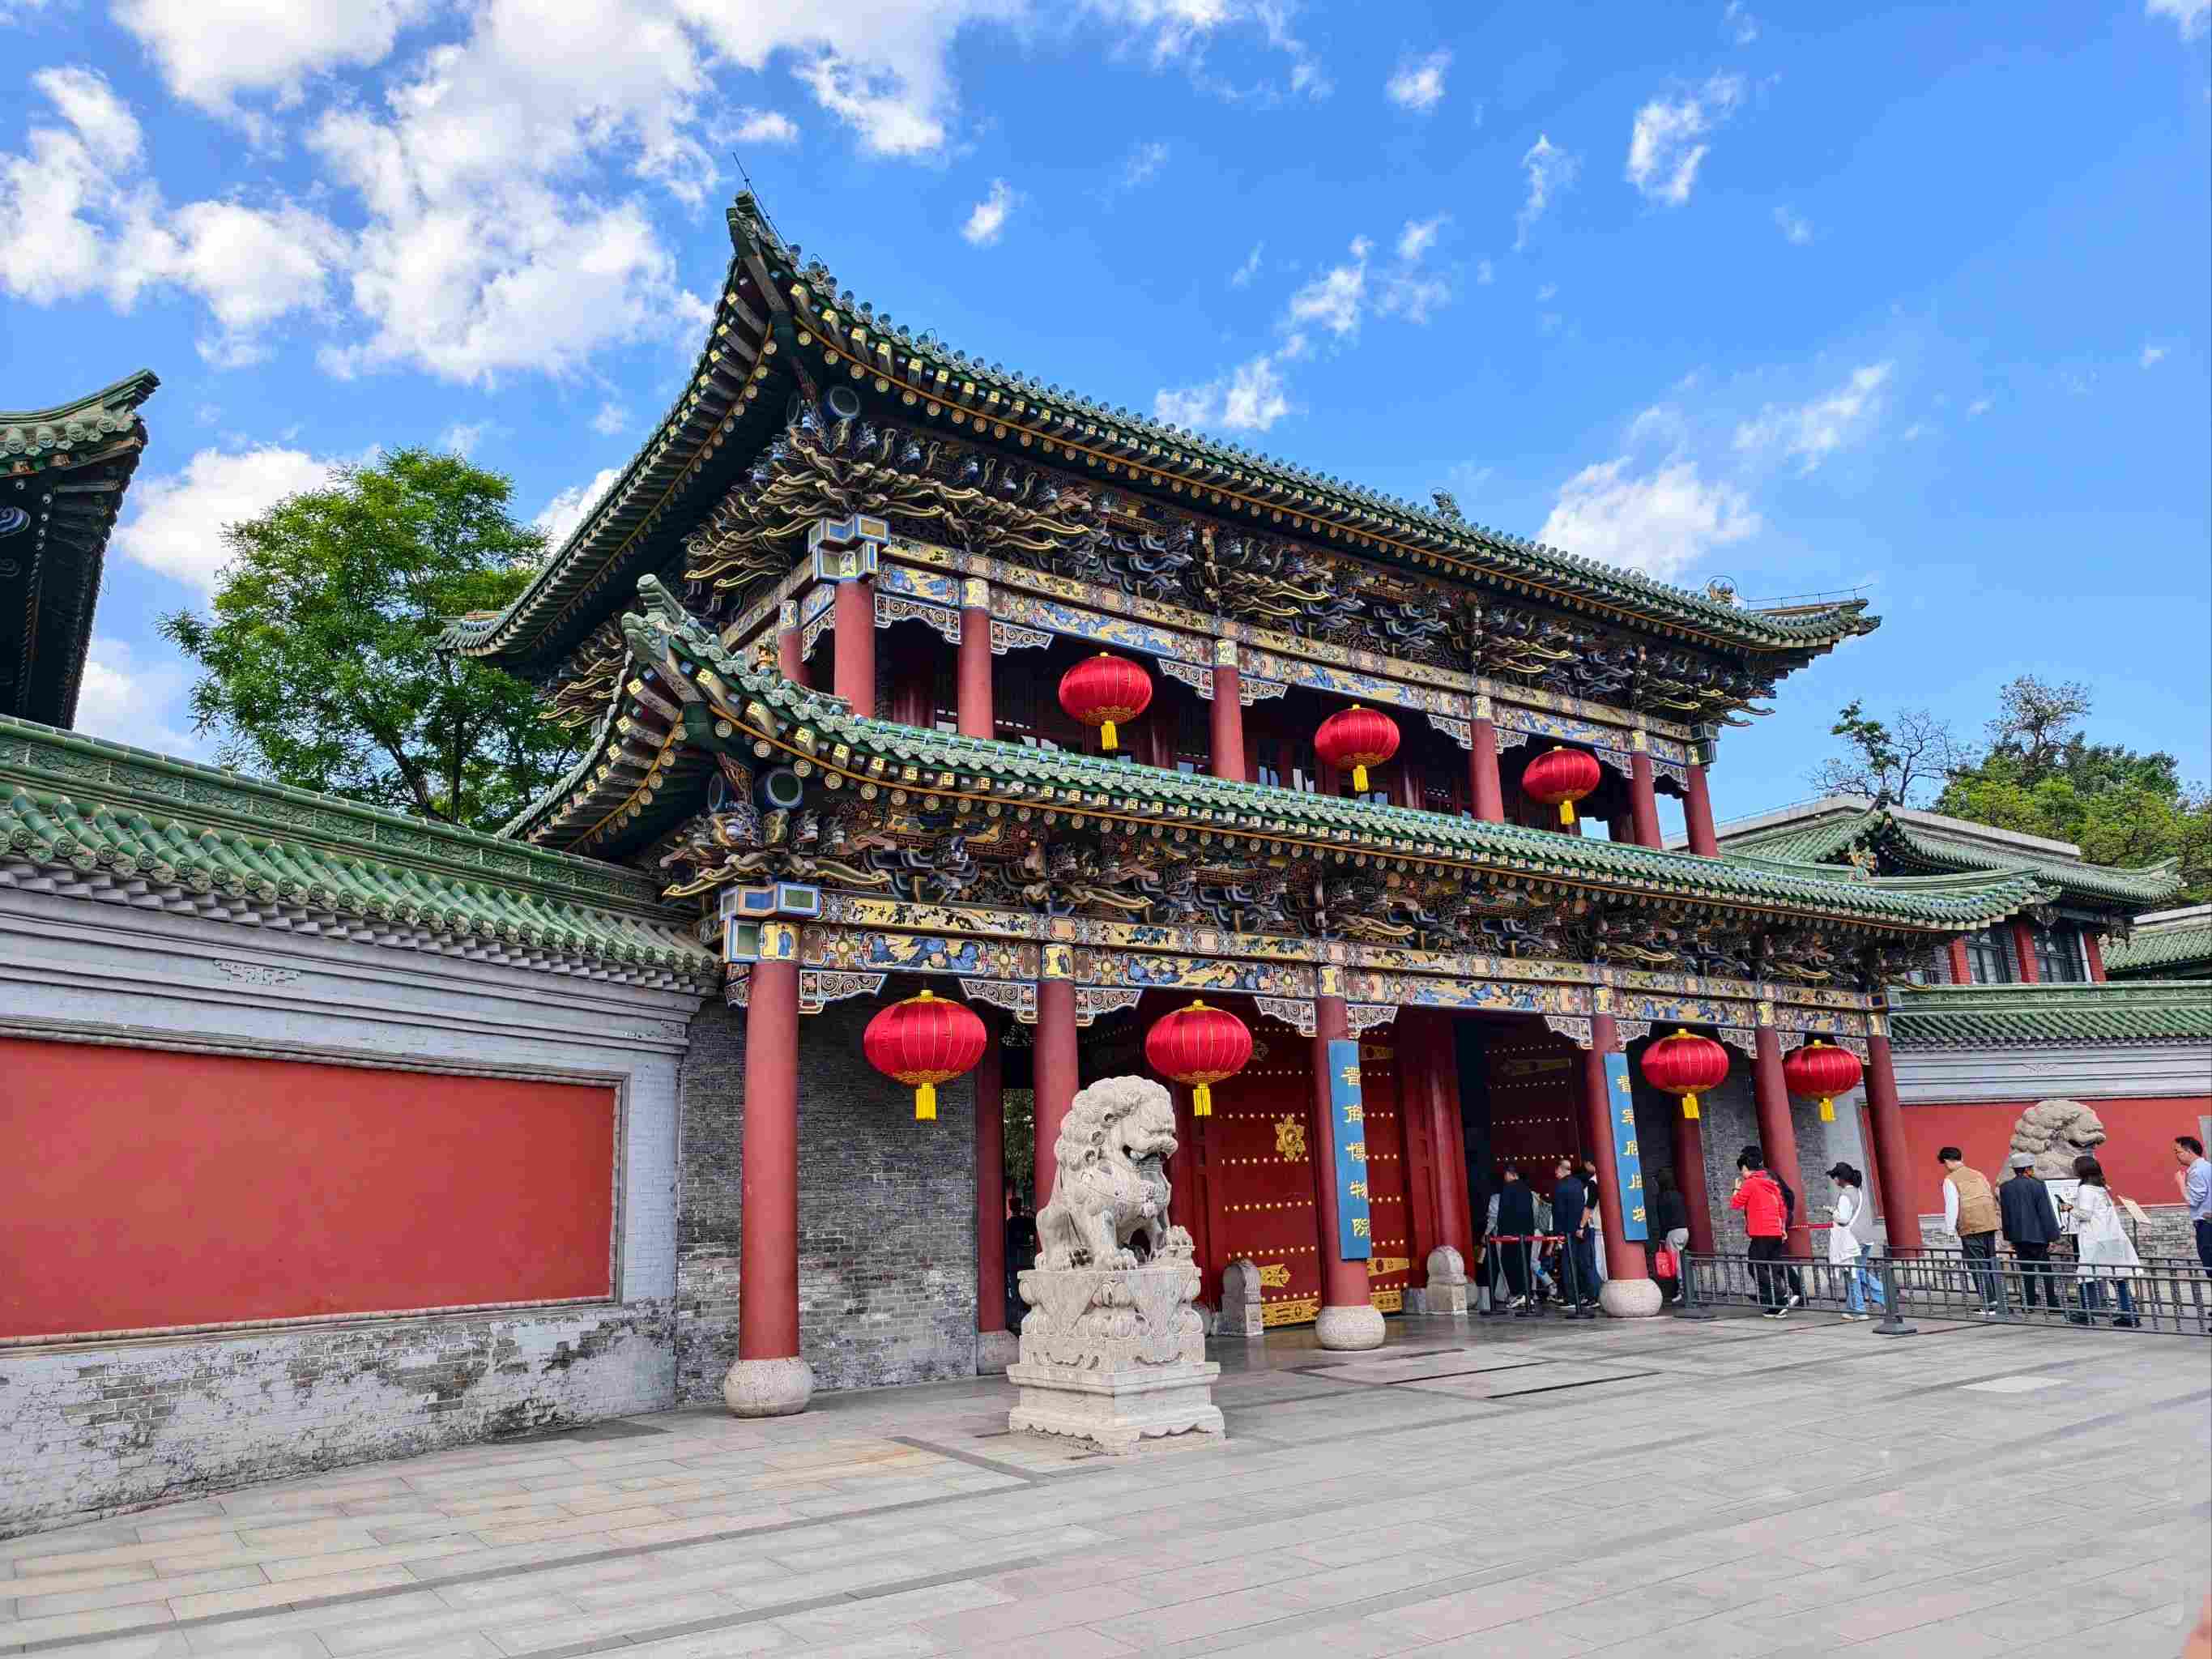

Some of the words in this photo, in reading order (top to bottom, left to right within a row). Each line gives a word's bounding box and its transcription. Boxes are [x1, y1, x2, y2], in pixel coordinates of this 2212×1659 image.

[1341, 1066, 1371, 1237] 晋商博物院
